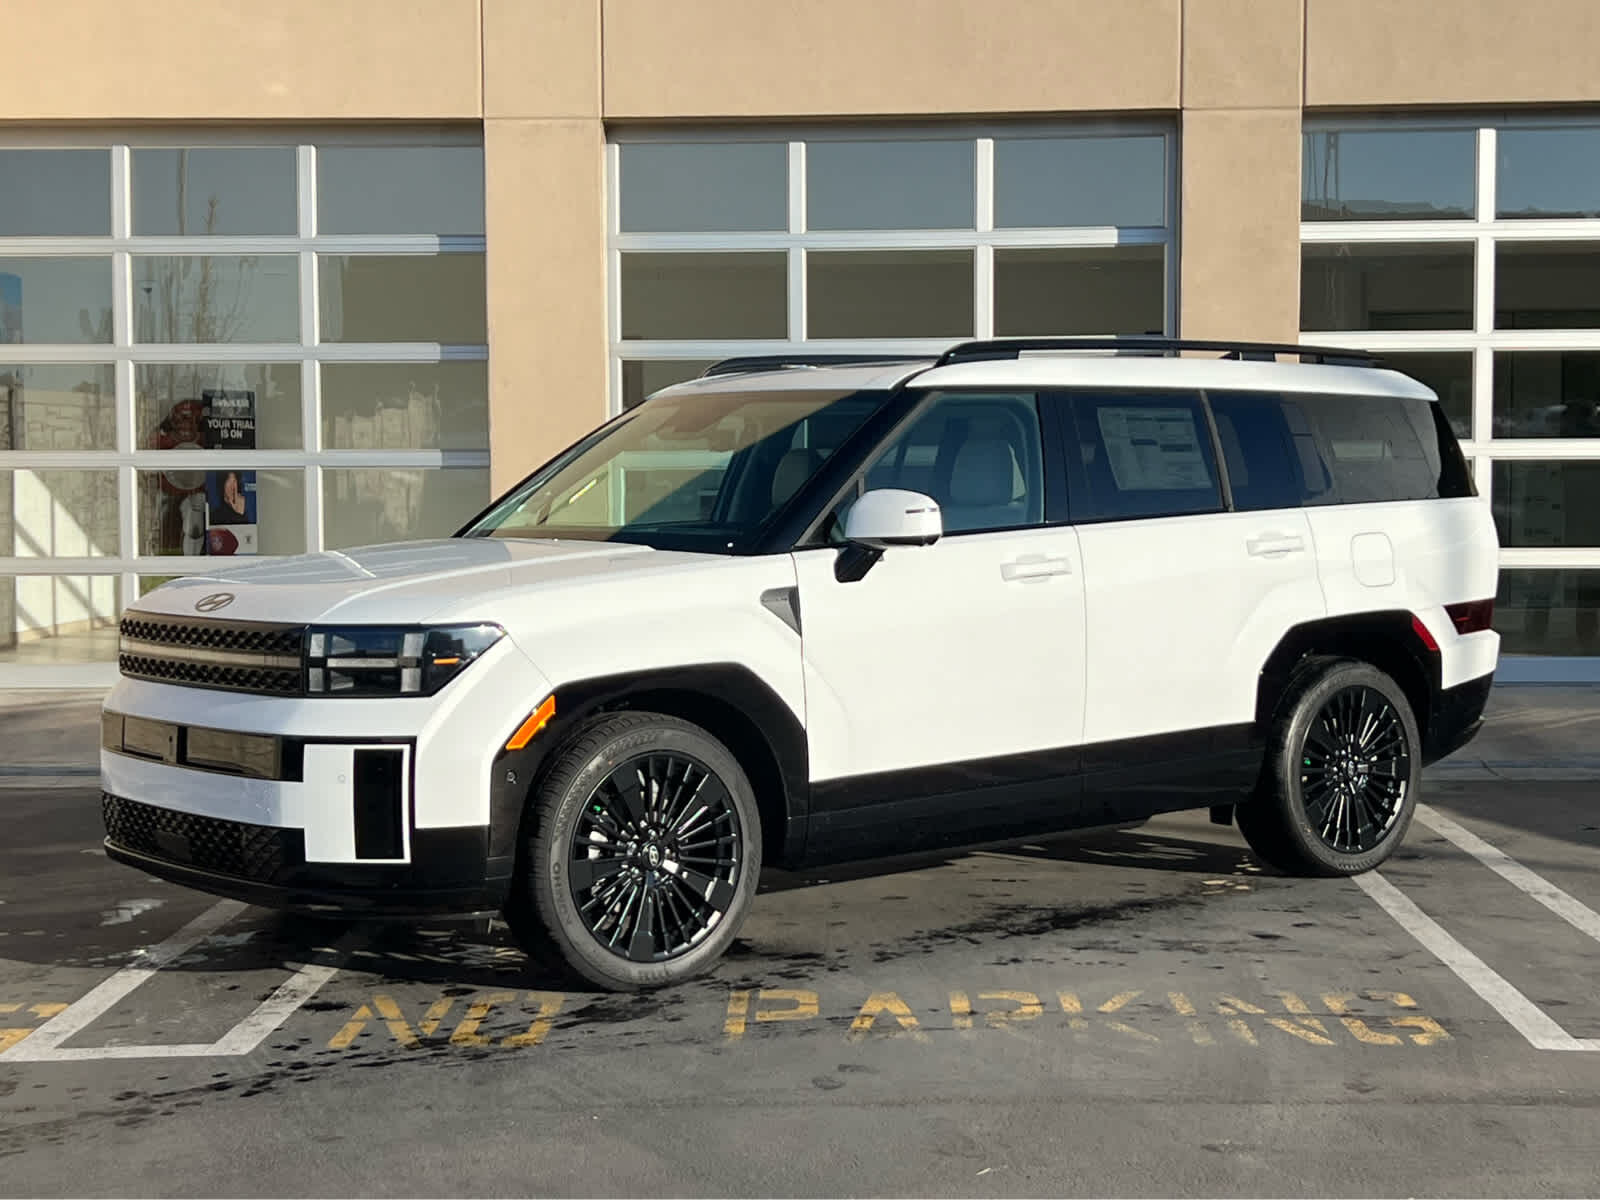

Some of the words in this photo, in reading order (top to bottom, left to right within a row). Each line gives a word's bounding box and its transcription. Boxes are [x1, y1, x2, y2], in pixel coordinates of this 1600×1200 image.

[207, 419, 230, 429] YOUR
[231, 419, 255, 429] TRIAL
[220, 429, 229, 439] IS
[230, 429, 243, 439] ON
[328, 990, 566, 1048] NO
[722, 989, 1452, 1047] PARKING
